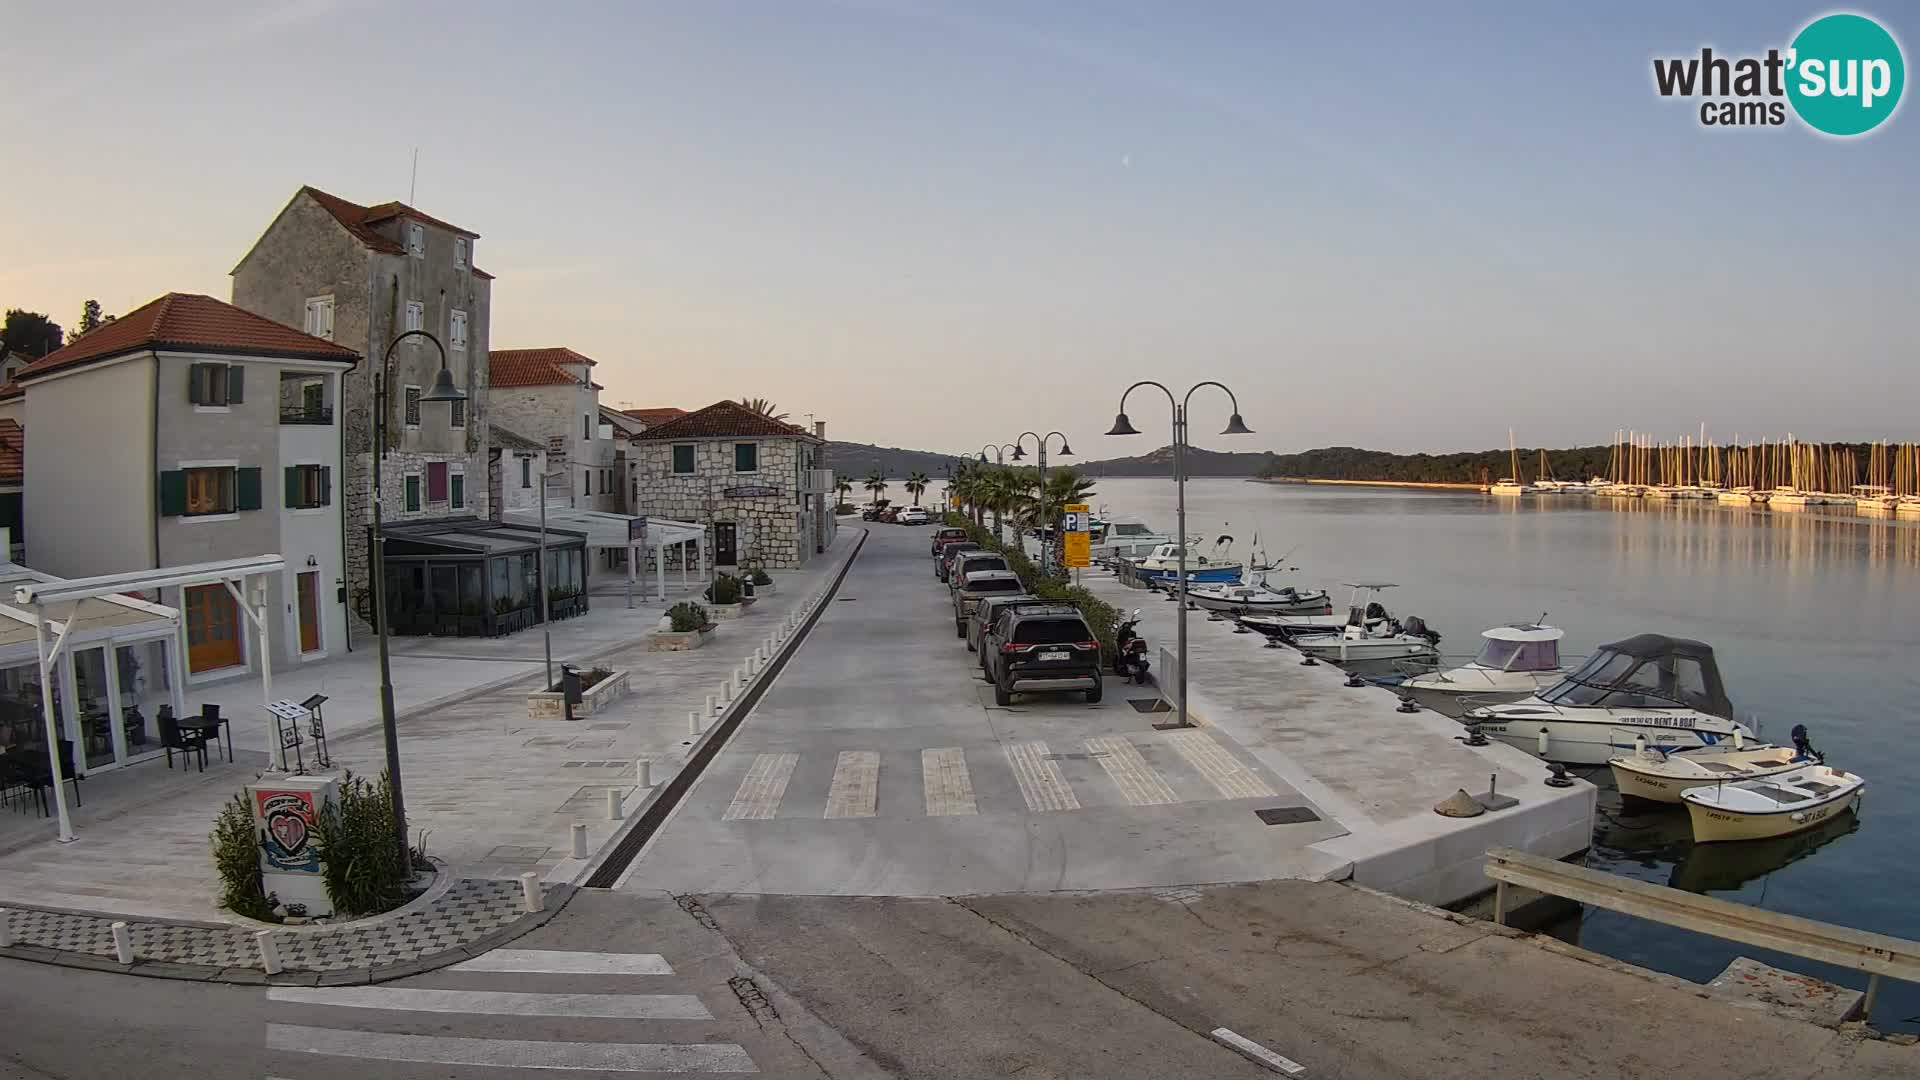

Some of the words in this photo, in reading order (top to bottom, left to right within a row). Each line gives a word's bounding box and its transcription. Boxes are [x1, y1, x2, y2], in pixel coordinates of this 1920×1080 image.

[1066, 514, 1077, 530] P
[1654, 717, 1673, 726] RENT
[1673, 717, 1678, 727] A
[1680, 717, 1697, 728] BOAT
